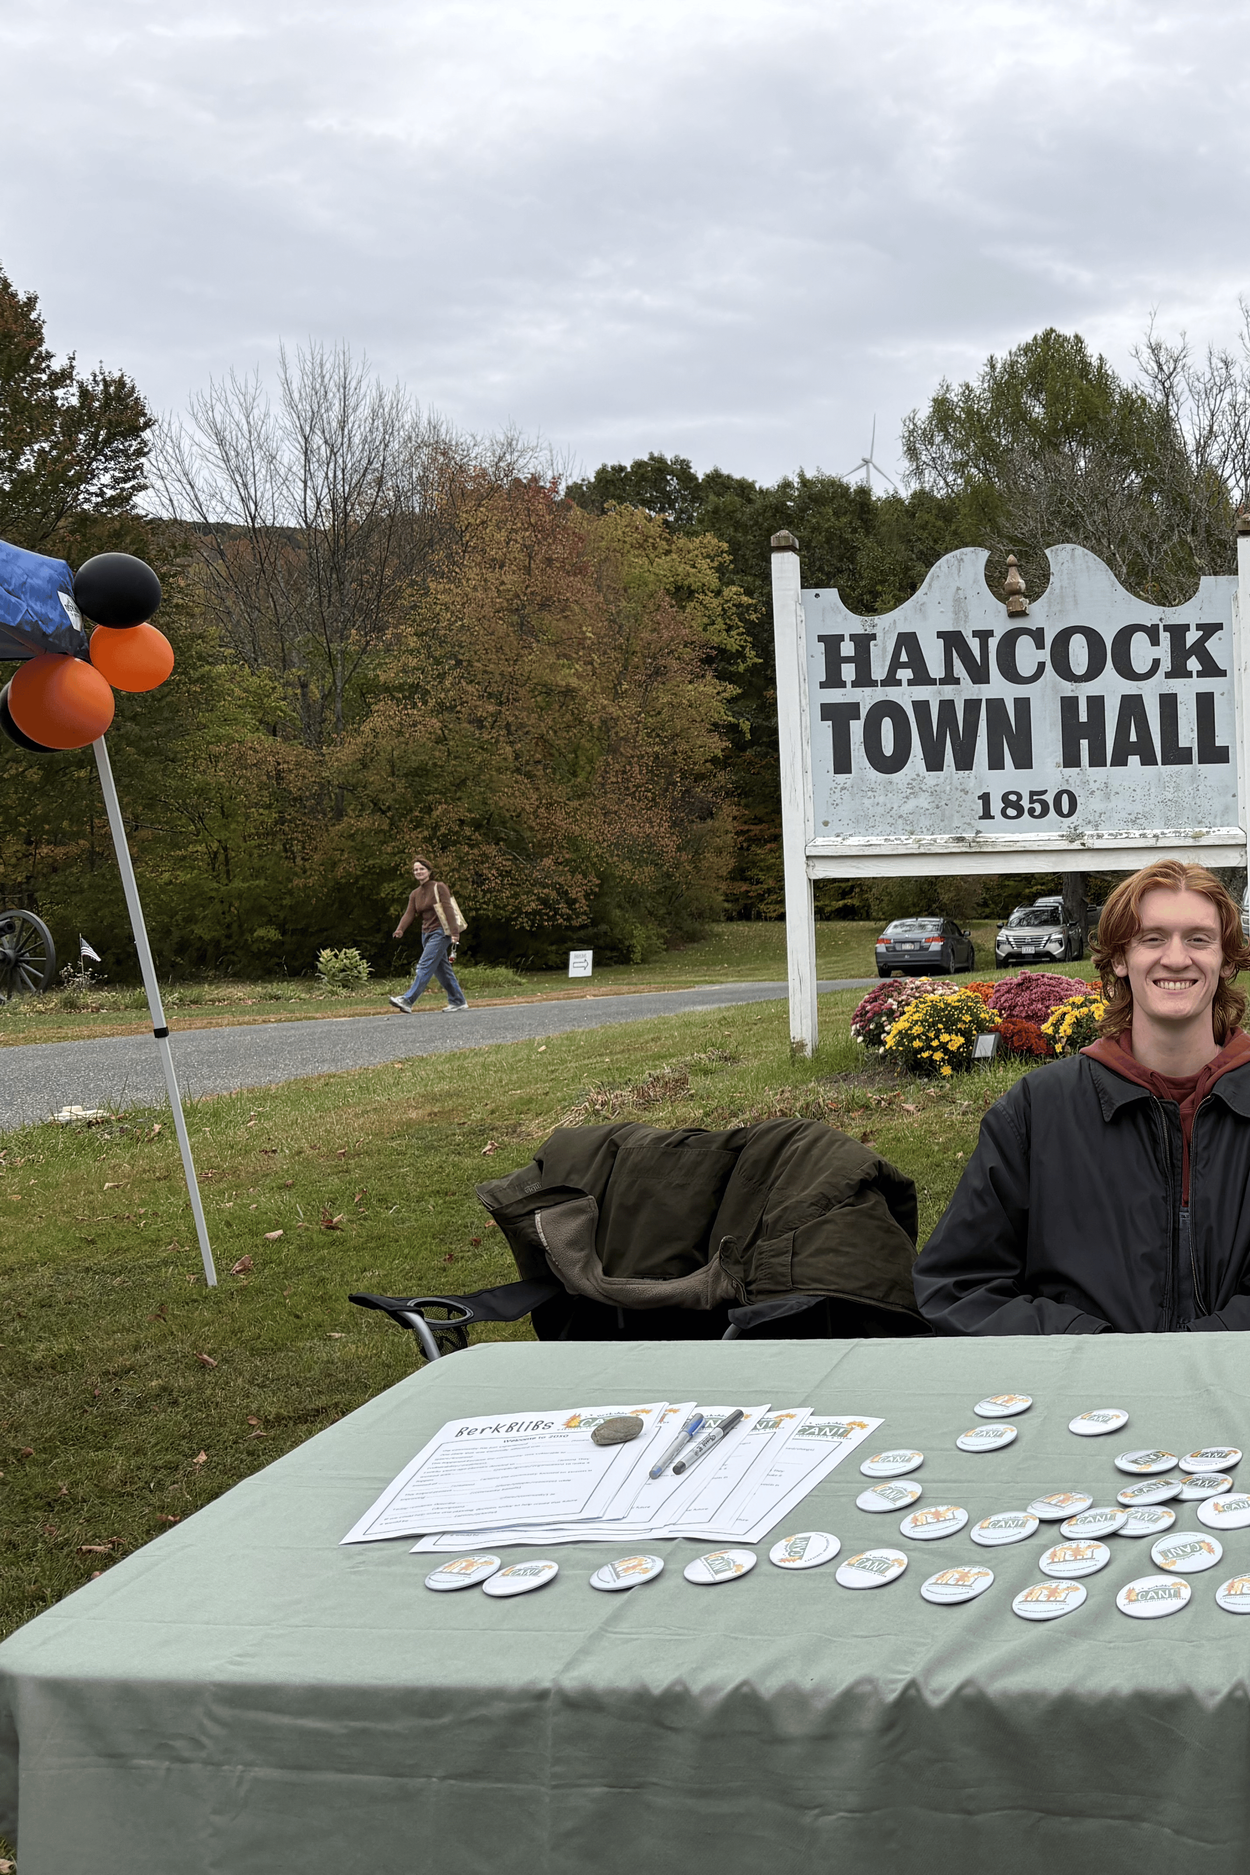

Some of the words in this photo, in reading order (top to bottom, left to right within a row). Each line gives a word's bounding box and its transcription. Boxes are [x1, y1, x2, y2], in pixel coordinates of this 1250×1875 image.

[817, 622, 1227, 689] HANCOCK
[820, 697, 1033, 775] TOWN
[1060, 691, 1230, 769] HALL
[977, 788, 1078, 820] 1850
[989, 1519, 1023, 1528] CAN!
[1138, 1589, 1175, 1600] CAN!
